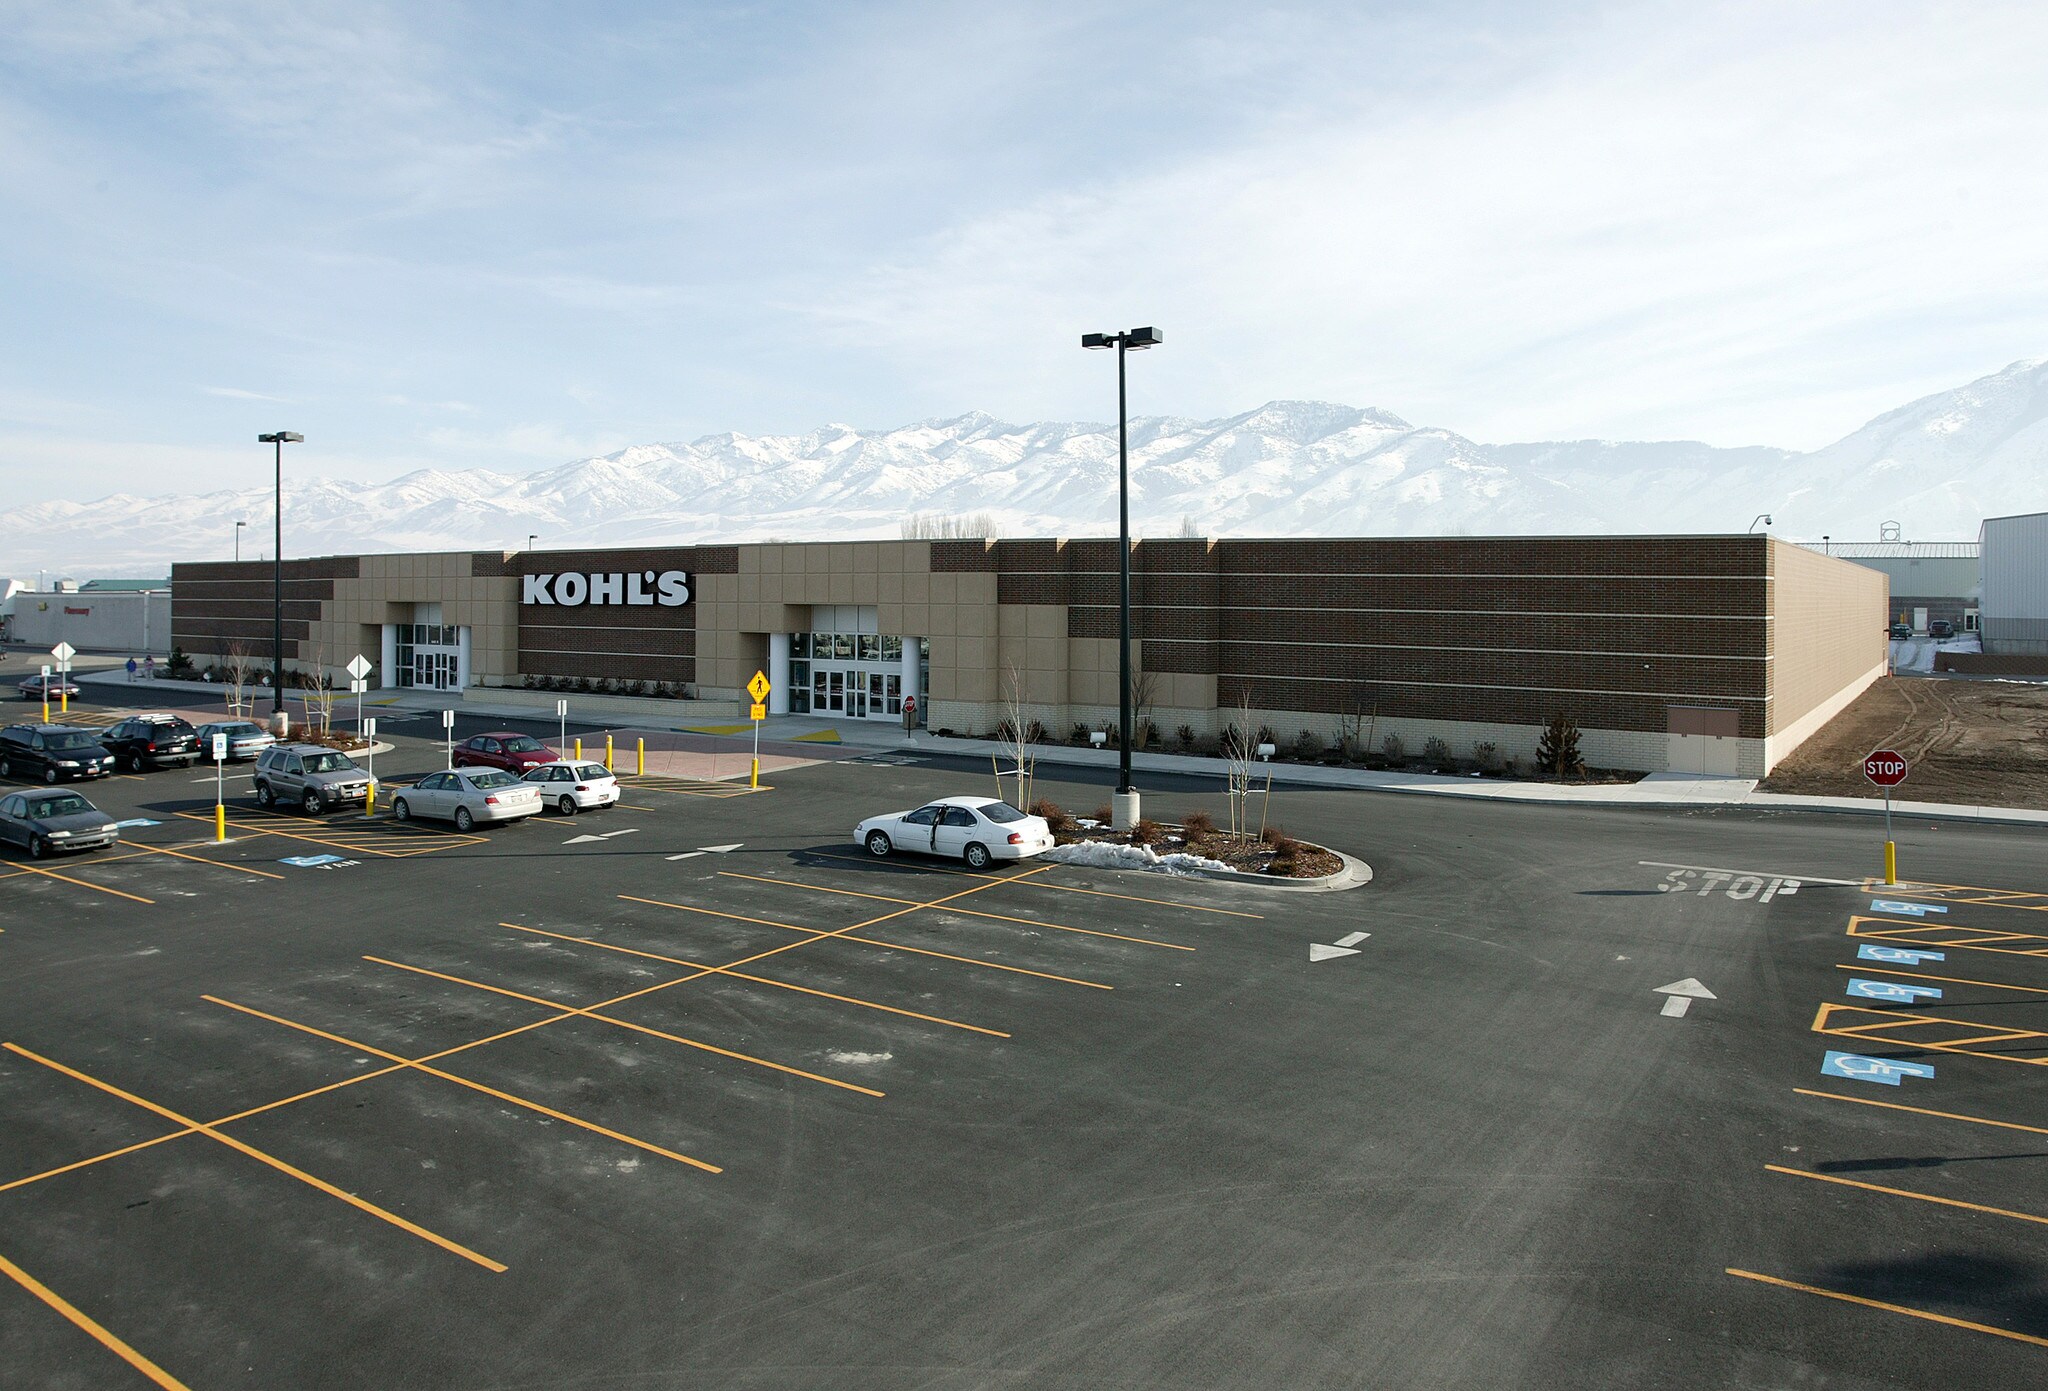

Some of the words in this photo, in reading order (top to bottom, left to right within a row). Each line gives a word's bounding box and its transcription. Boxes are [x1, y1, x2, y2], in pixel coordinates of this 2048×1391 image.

[523, 570, 689, 607] KOHL'S
[1867, 761, 1904, 775] STOP
[316, 860, 362, 870] VAN
[1657, 869, 1801, 903] STOP
